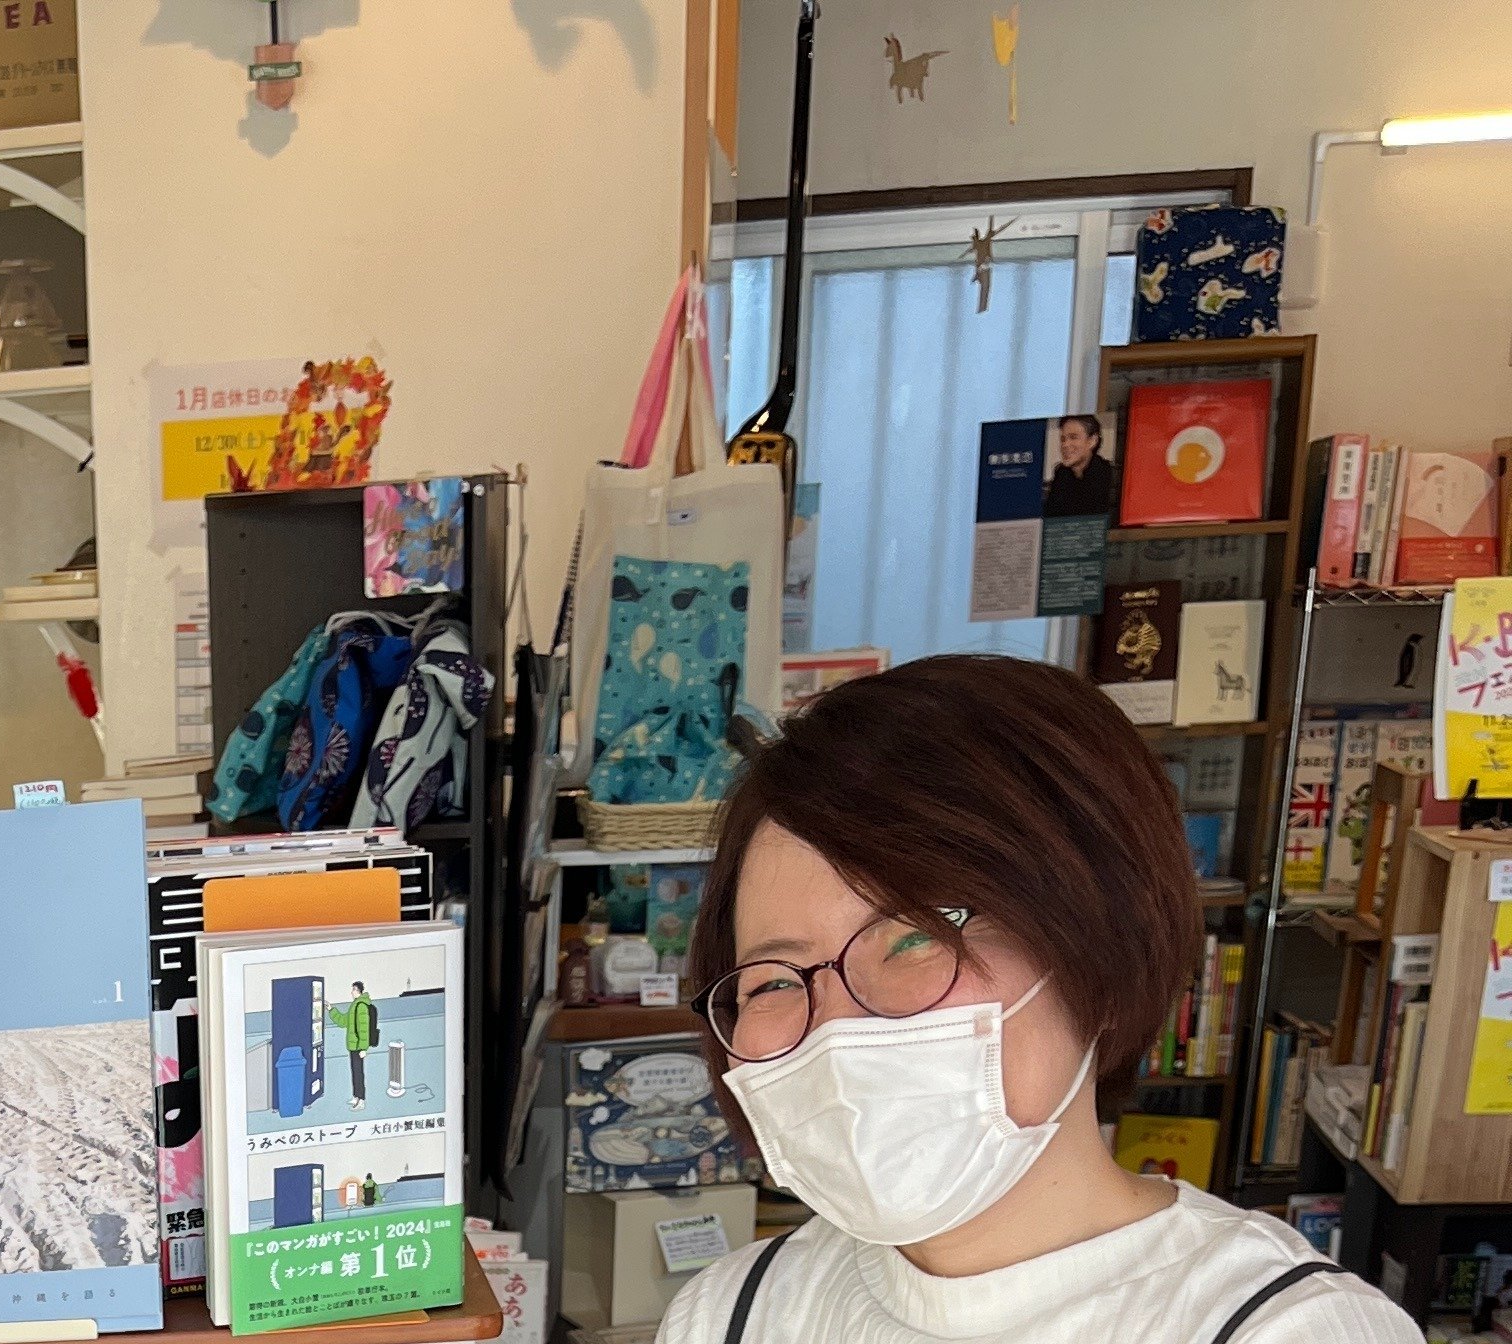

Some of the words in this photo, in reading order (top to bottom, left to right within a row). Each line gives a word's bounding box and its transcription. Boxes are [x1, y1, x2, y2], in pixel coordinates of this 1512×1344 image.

[247, 1124, 359, 1153] うみべのストーブ
[371, 1116, 446, 1136] 大白小蟹短編集
